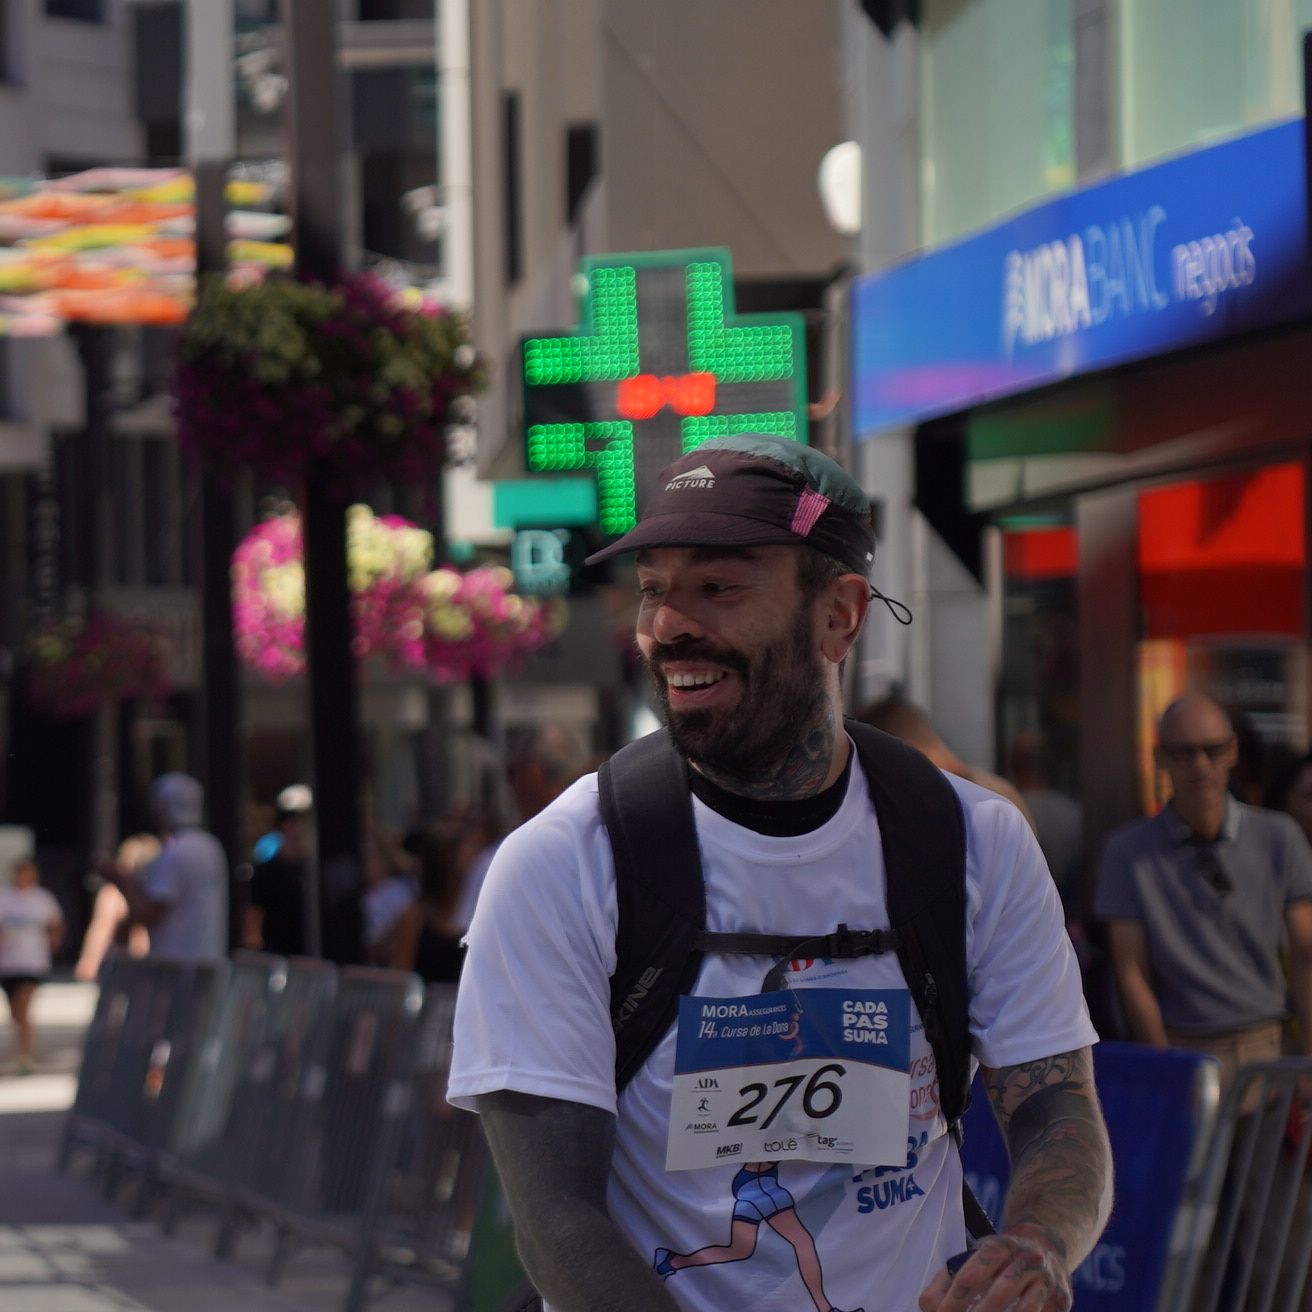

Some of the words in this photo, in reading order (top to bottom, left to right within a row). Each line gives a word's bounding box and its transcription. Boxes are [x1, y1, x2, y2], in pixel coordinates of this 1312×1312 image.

[665, 479, 716, 492] PICTURE
[702, 1004, 748, 1018] MORA
[842, 1001, 888, 1013] CADA
[842, 1014, 889, 1030] PAS
[722, 1026, 748, 1038] Cursa
[749, 1024, 761, 1036] de
[763, 1022, 773, 1035] la
[773, 1021, 789, 1034] Dona
[843, 1030, 889, 1045] SUMA
[695, 1078, 720, 1090] ADA
[726, 1064, 847, 1130] 276
[694, 1122, 717, 1130] MORA
[716, 1143, 744, 1156] MKB!
[857, 1173, 925, 1214] SUMA
